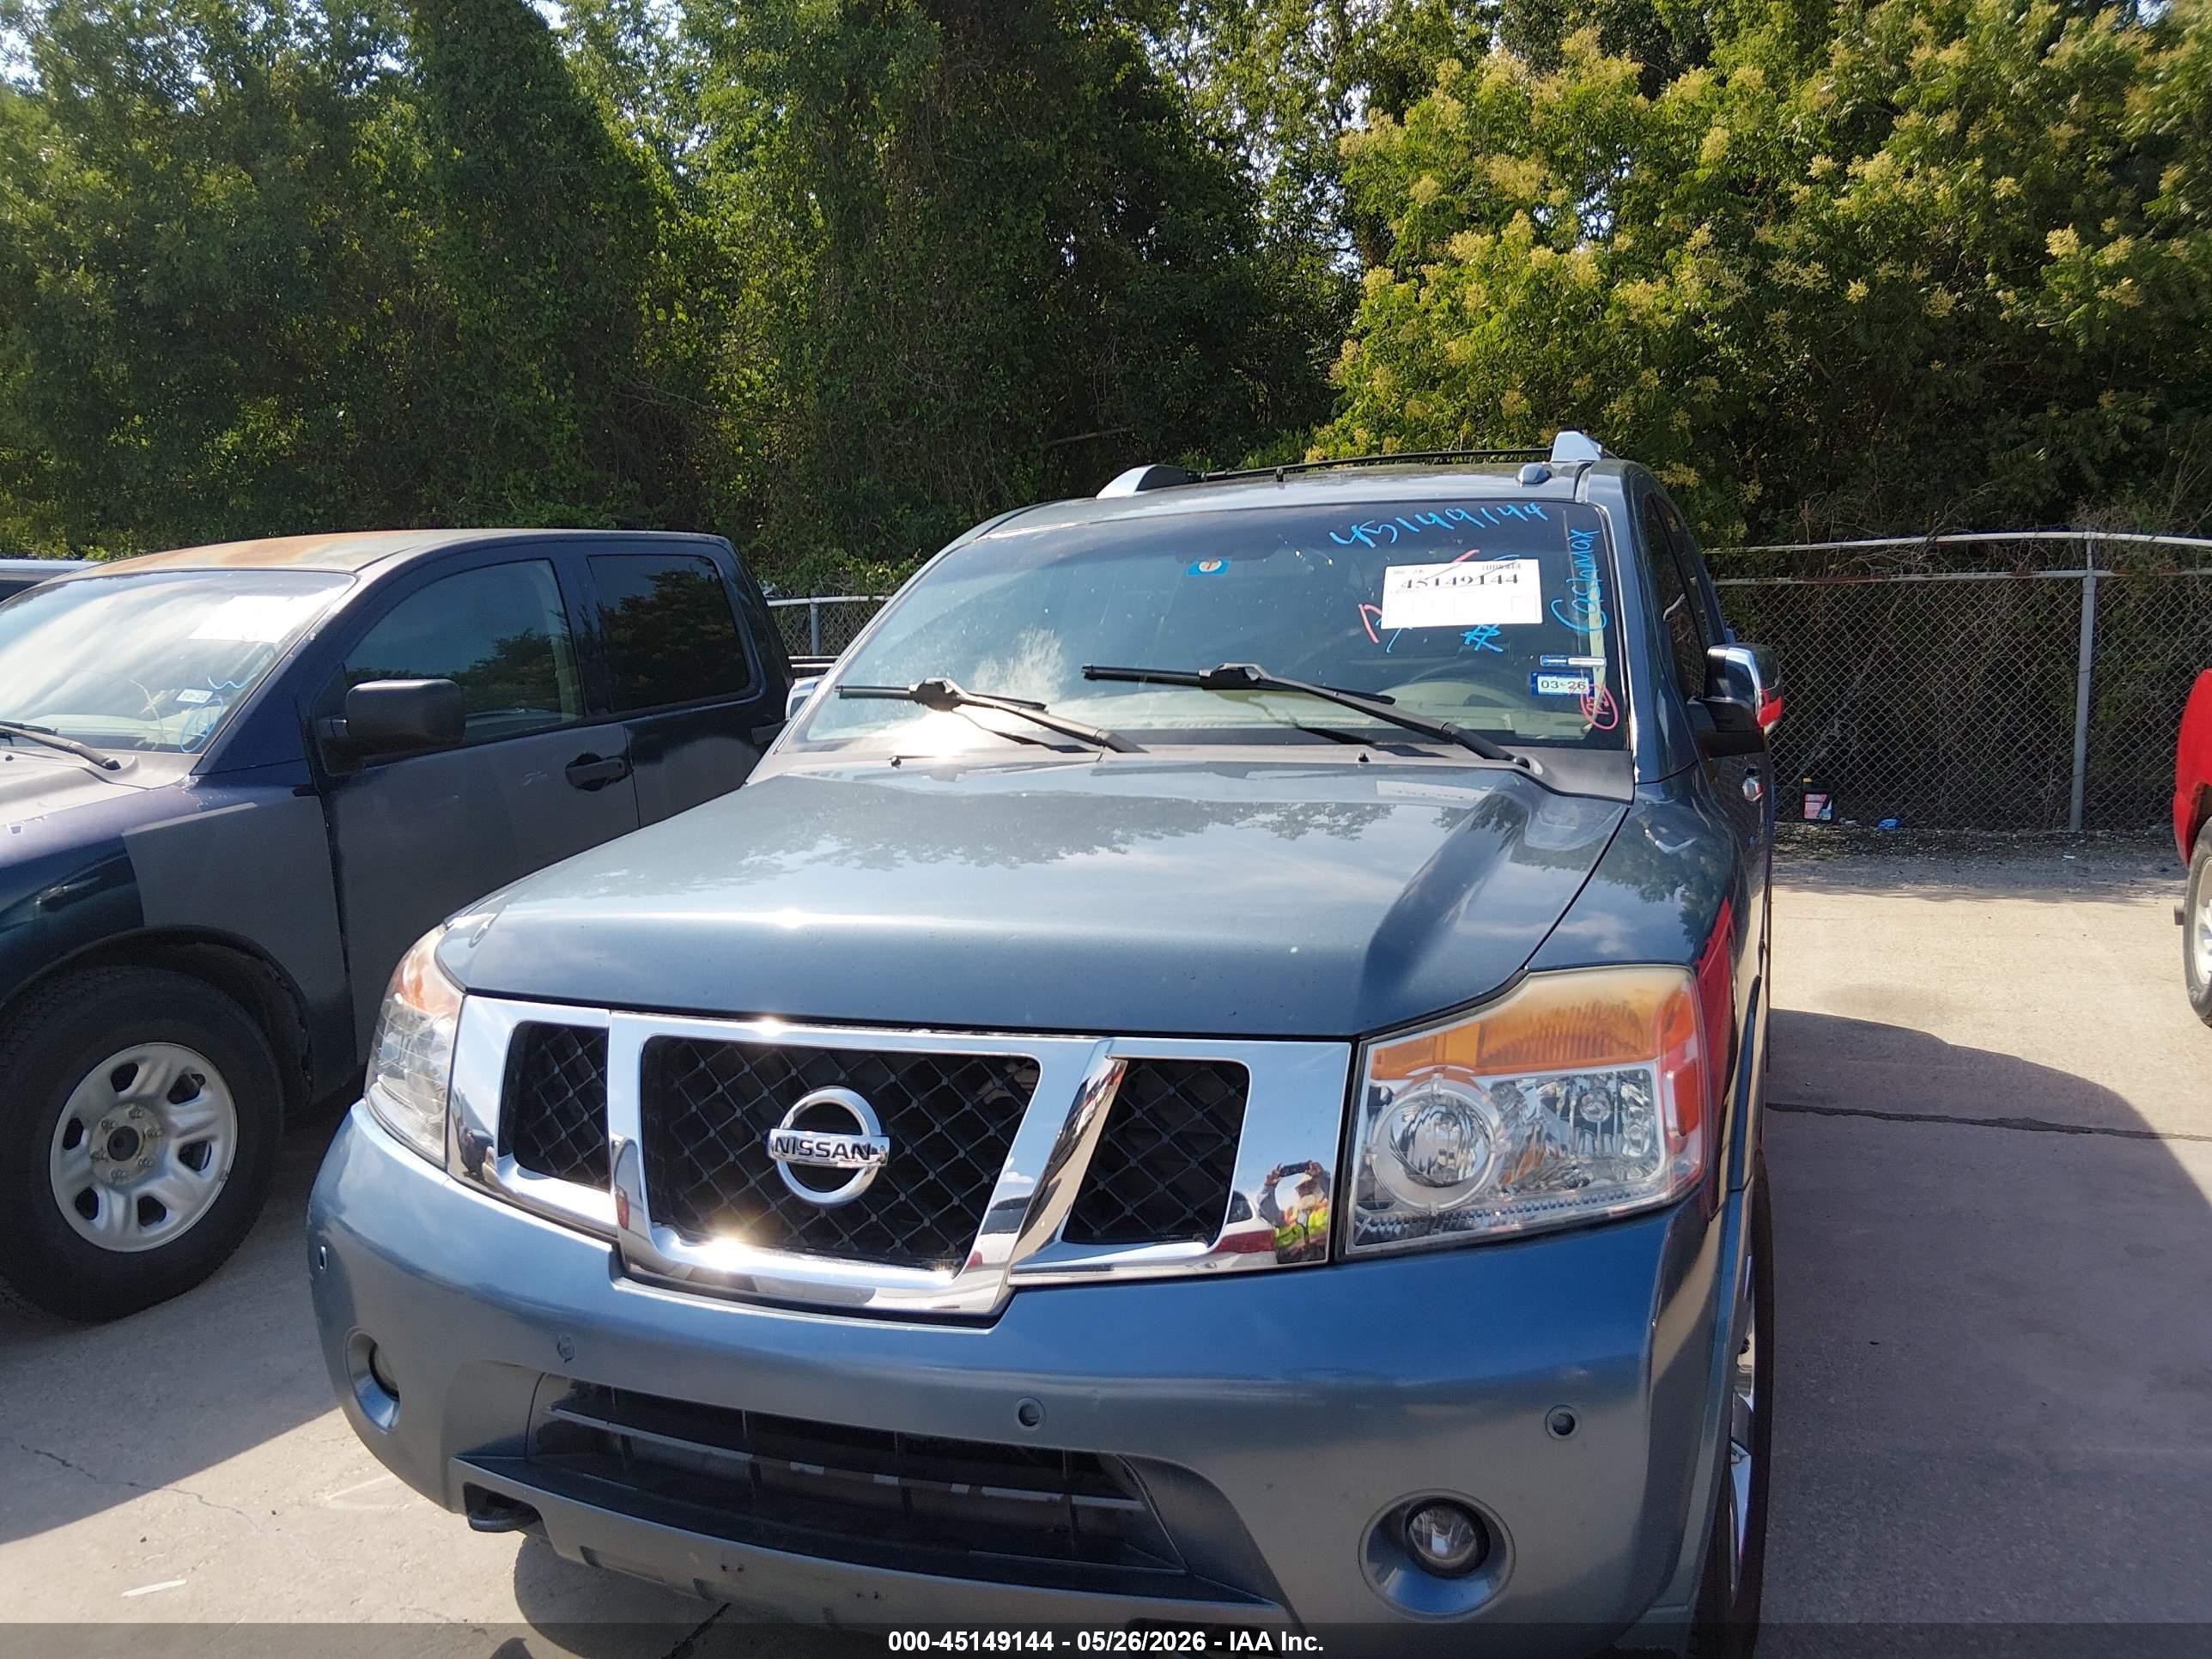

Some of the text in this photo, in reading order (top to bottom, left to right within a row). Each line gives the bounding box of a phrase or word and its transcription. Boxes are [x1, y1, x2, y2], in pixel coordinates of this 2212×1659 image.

[1328, 501, 1548, 549] 45149144
[1401, 573, 1518, 589] 45149144
[774, 1136, 872, 1161] NISSAN
